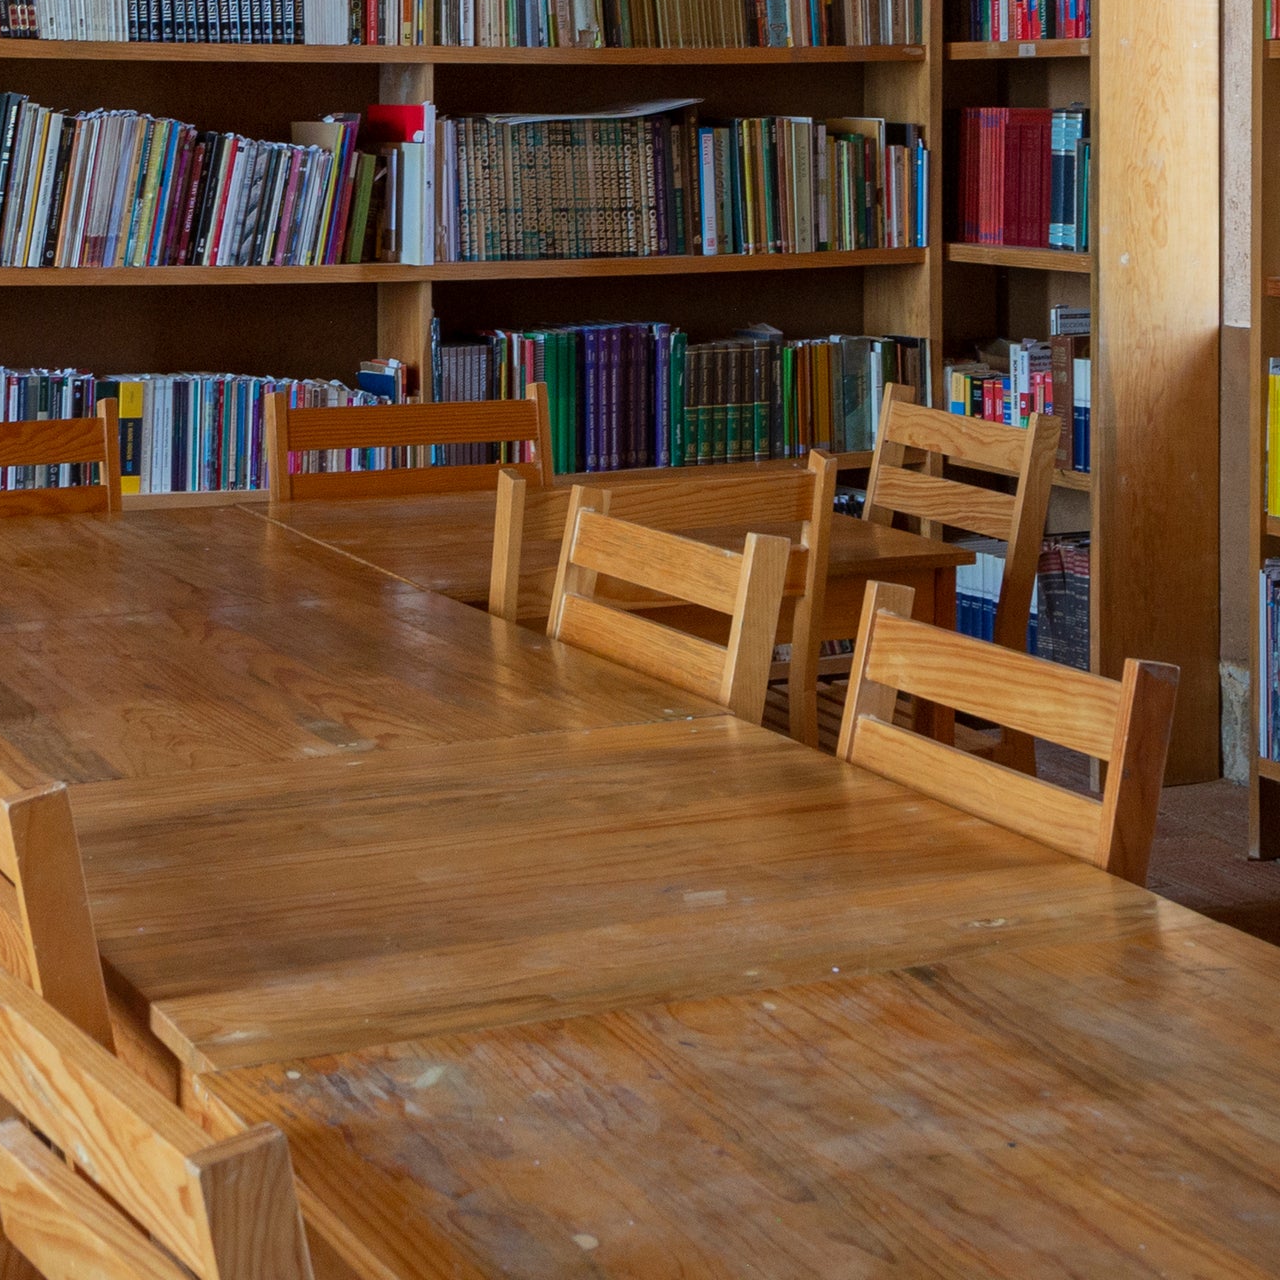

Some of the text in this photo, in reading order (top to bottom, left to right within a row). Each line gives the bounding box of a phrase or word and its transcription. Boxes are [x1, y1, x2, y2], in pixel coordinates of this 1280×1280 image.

[624, 145, 637, 252] MUNDO SUBMARINO
[646, 144, 658, 250] MUNDO SUBMARINO
